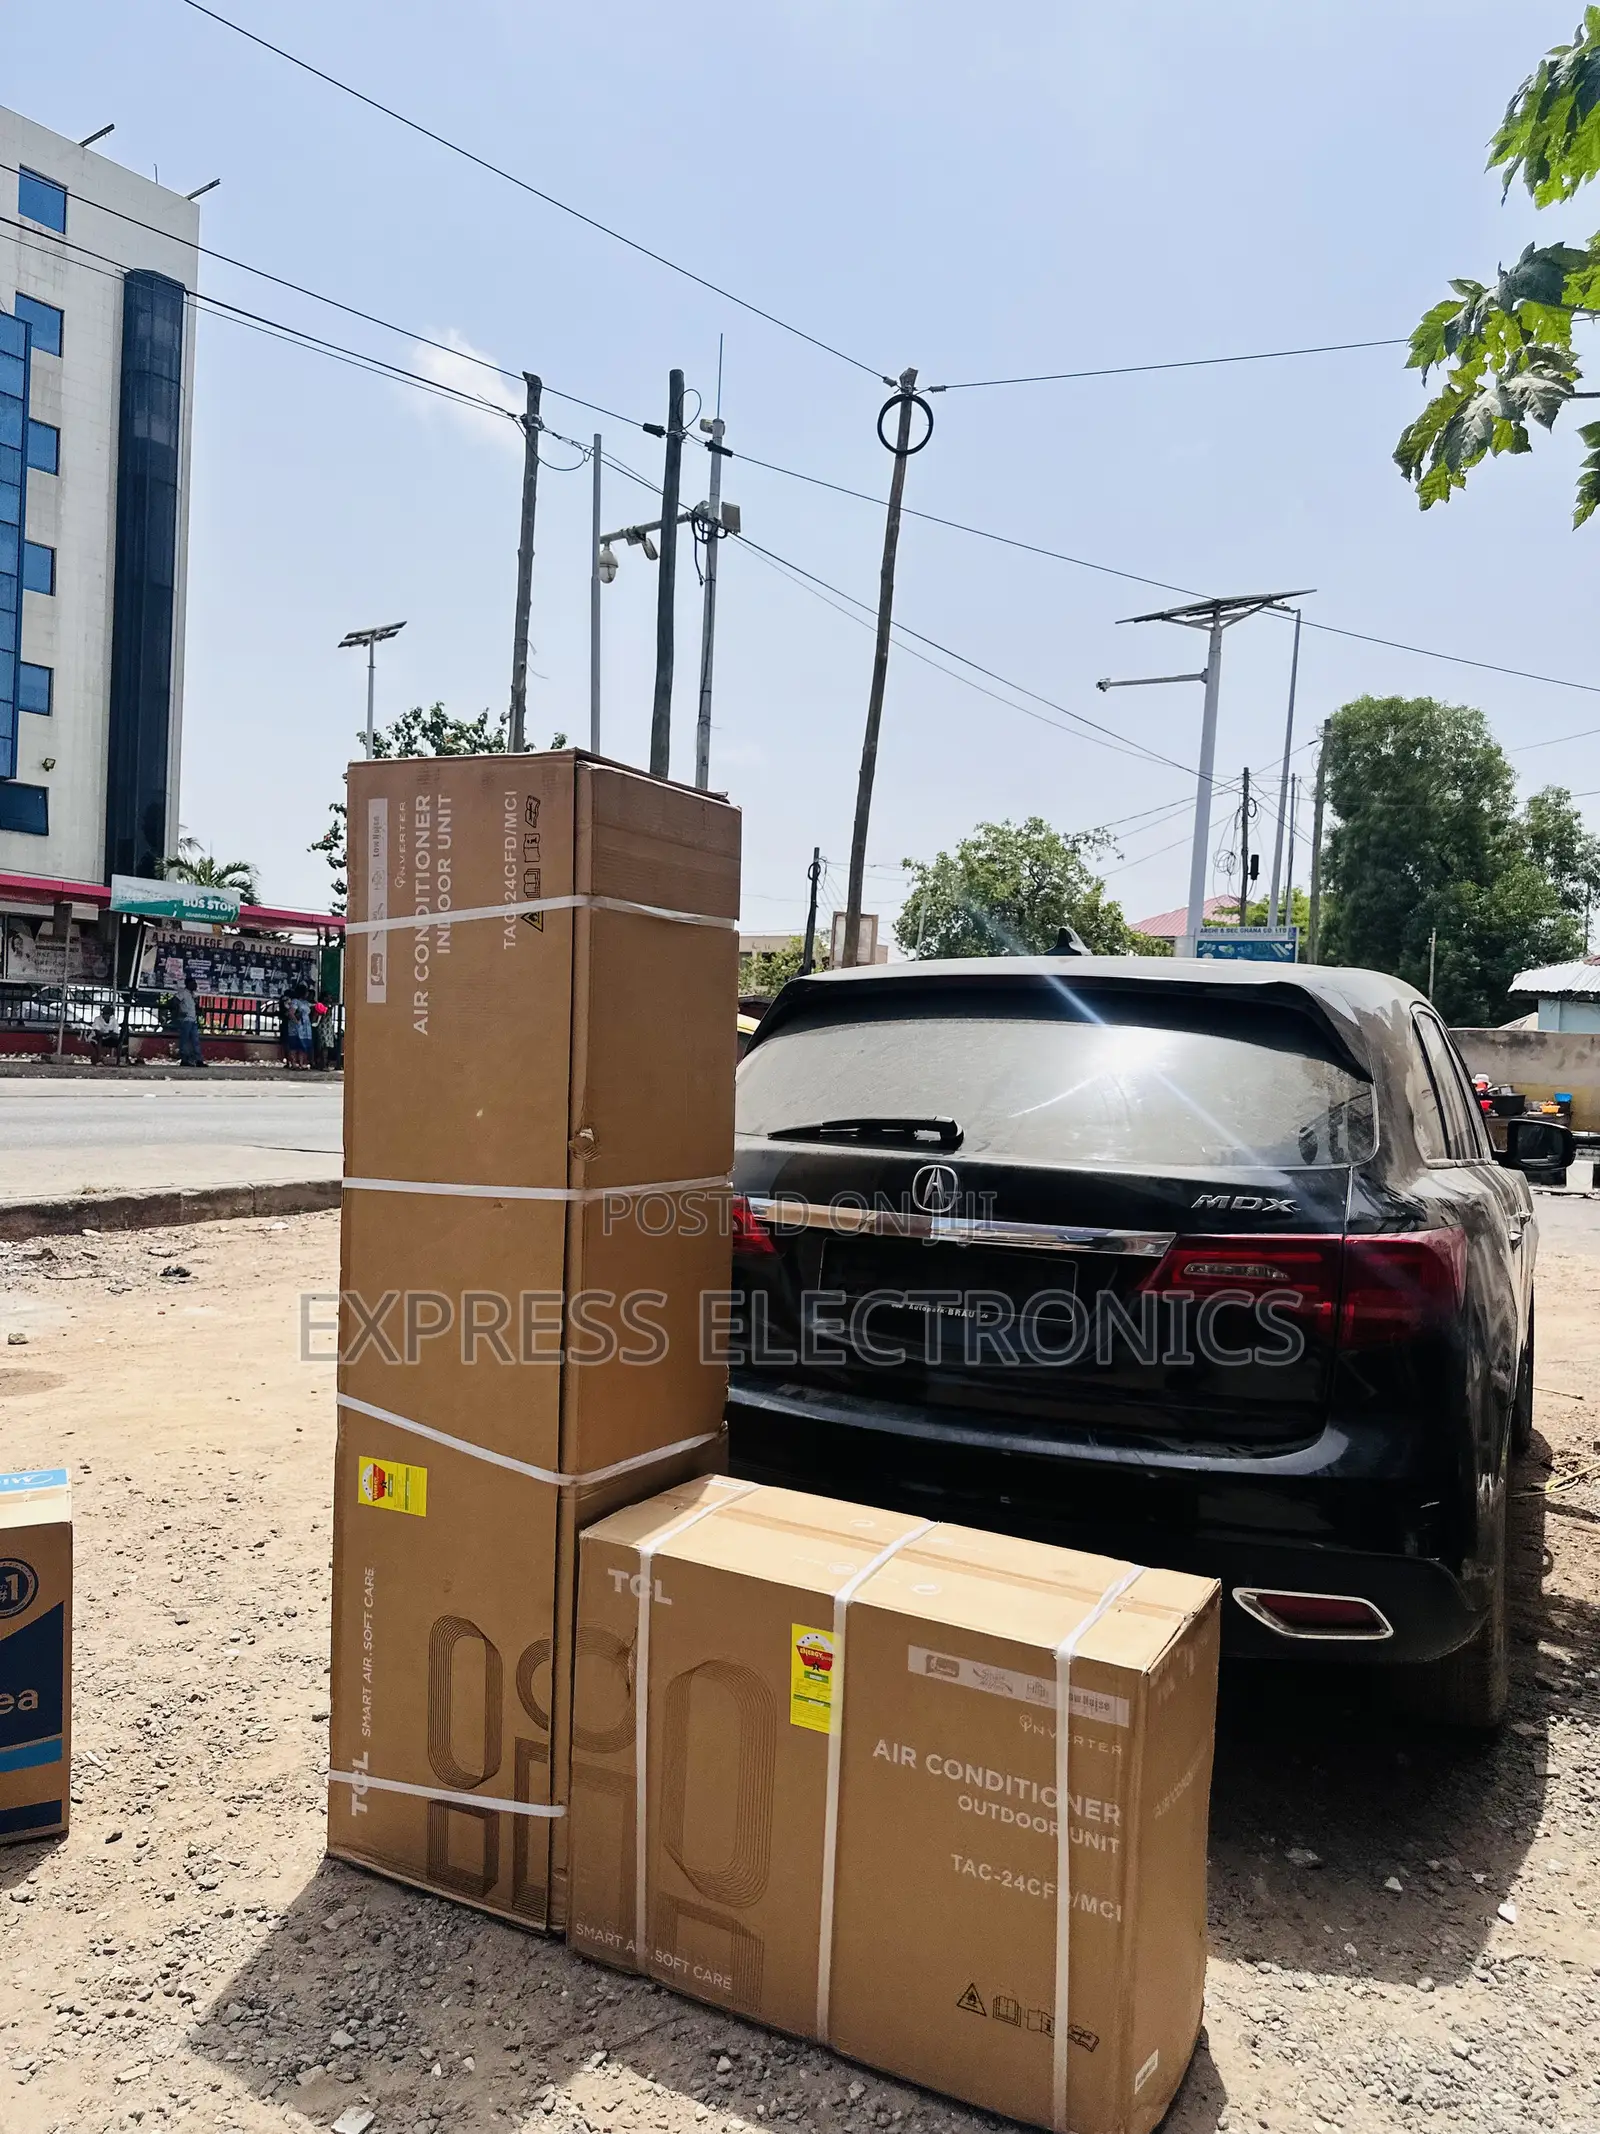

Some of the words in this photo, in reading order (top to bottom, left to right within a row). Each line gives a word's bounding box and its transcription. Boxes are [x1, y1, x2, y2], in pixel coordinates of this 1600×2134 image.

[438, 794, 452, 850] UNIT
[182, 899, 206, 908] BUS
[207, 900, 236, 912] STOP
[414, 794, 431, 982] CONDITIONER
[178, 934, 223, 949] COLLEGE
[413, 990, 429, 1036] AIR
[1191, 1195, 1297, 1213] MDX
[364, 1567, 375, 1608] CARE
[607, 1567, 673, 1606] TCL
[361, 1690, 372, 1737] SMART
[1083, 1694, 1110, 1712] Noise
[351, 1751, 369, 1817] TCL
[872, 1739, 917, 1769] AIR
[925, 1753, 1121, 1827] CONDITIONER
[1070, 1827, 1121, 1854] UNIT
[950, 1853, 1122, 1922] TAC-24CF/MCI
[576, 1923, 624, 1948] SMART
[693, 1965, 733, 1991] CARE
